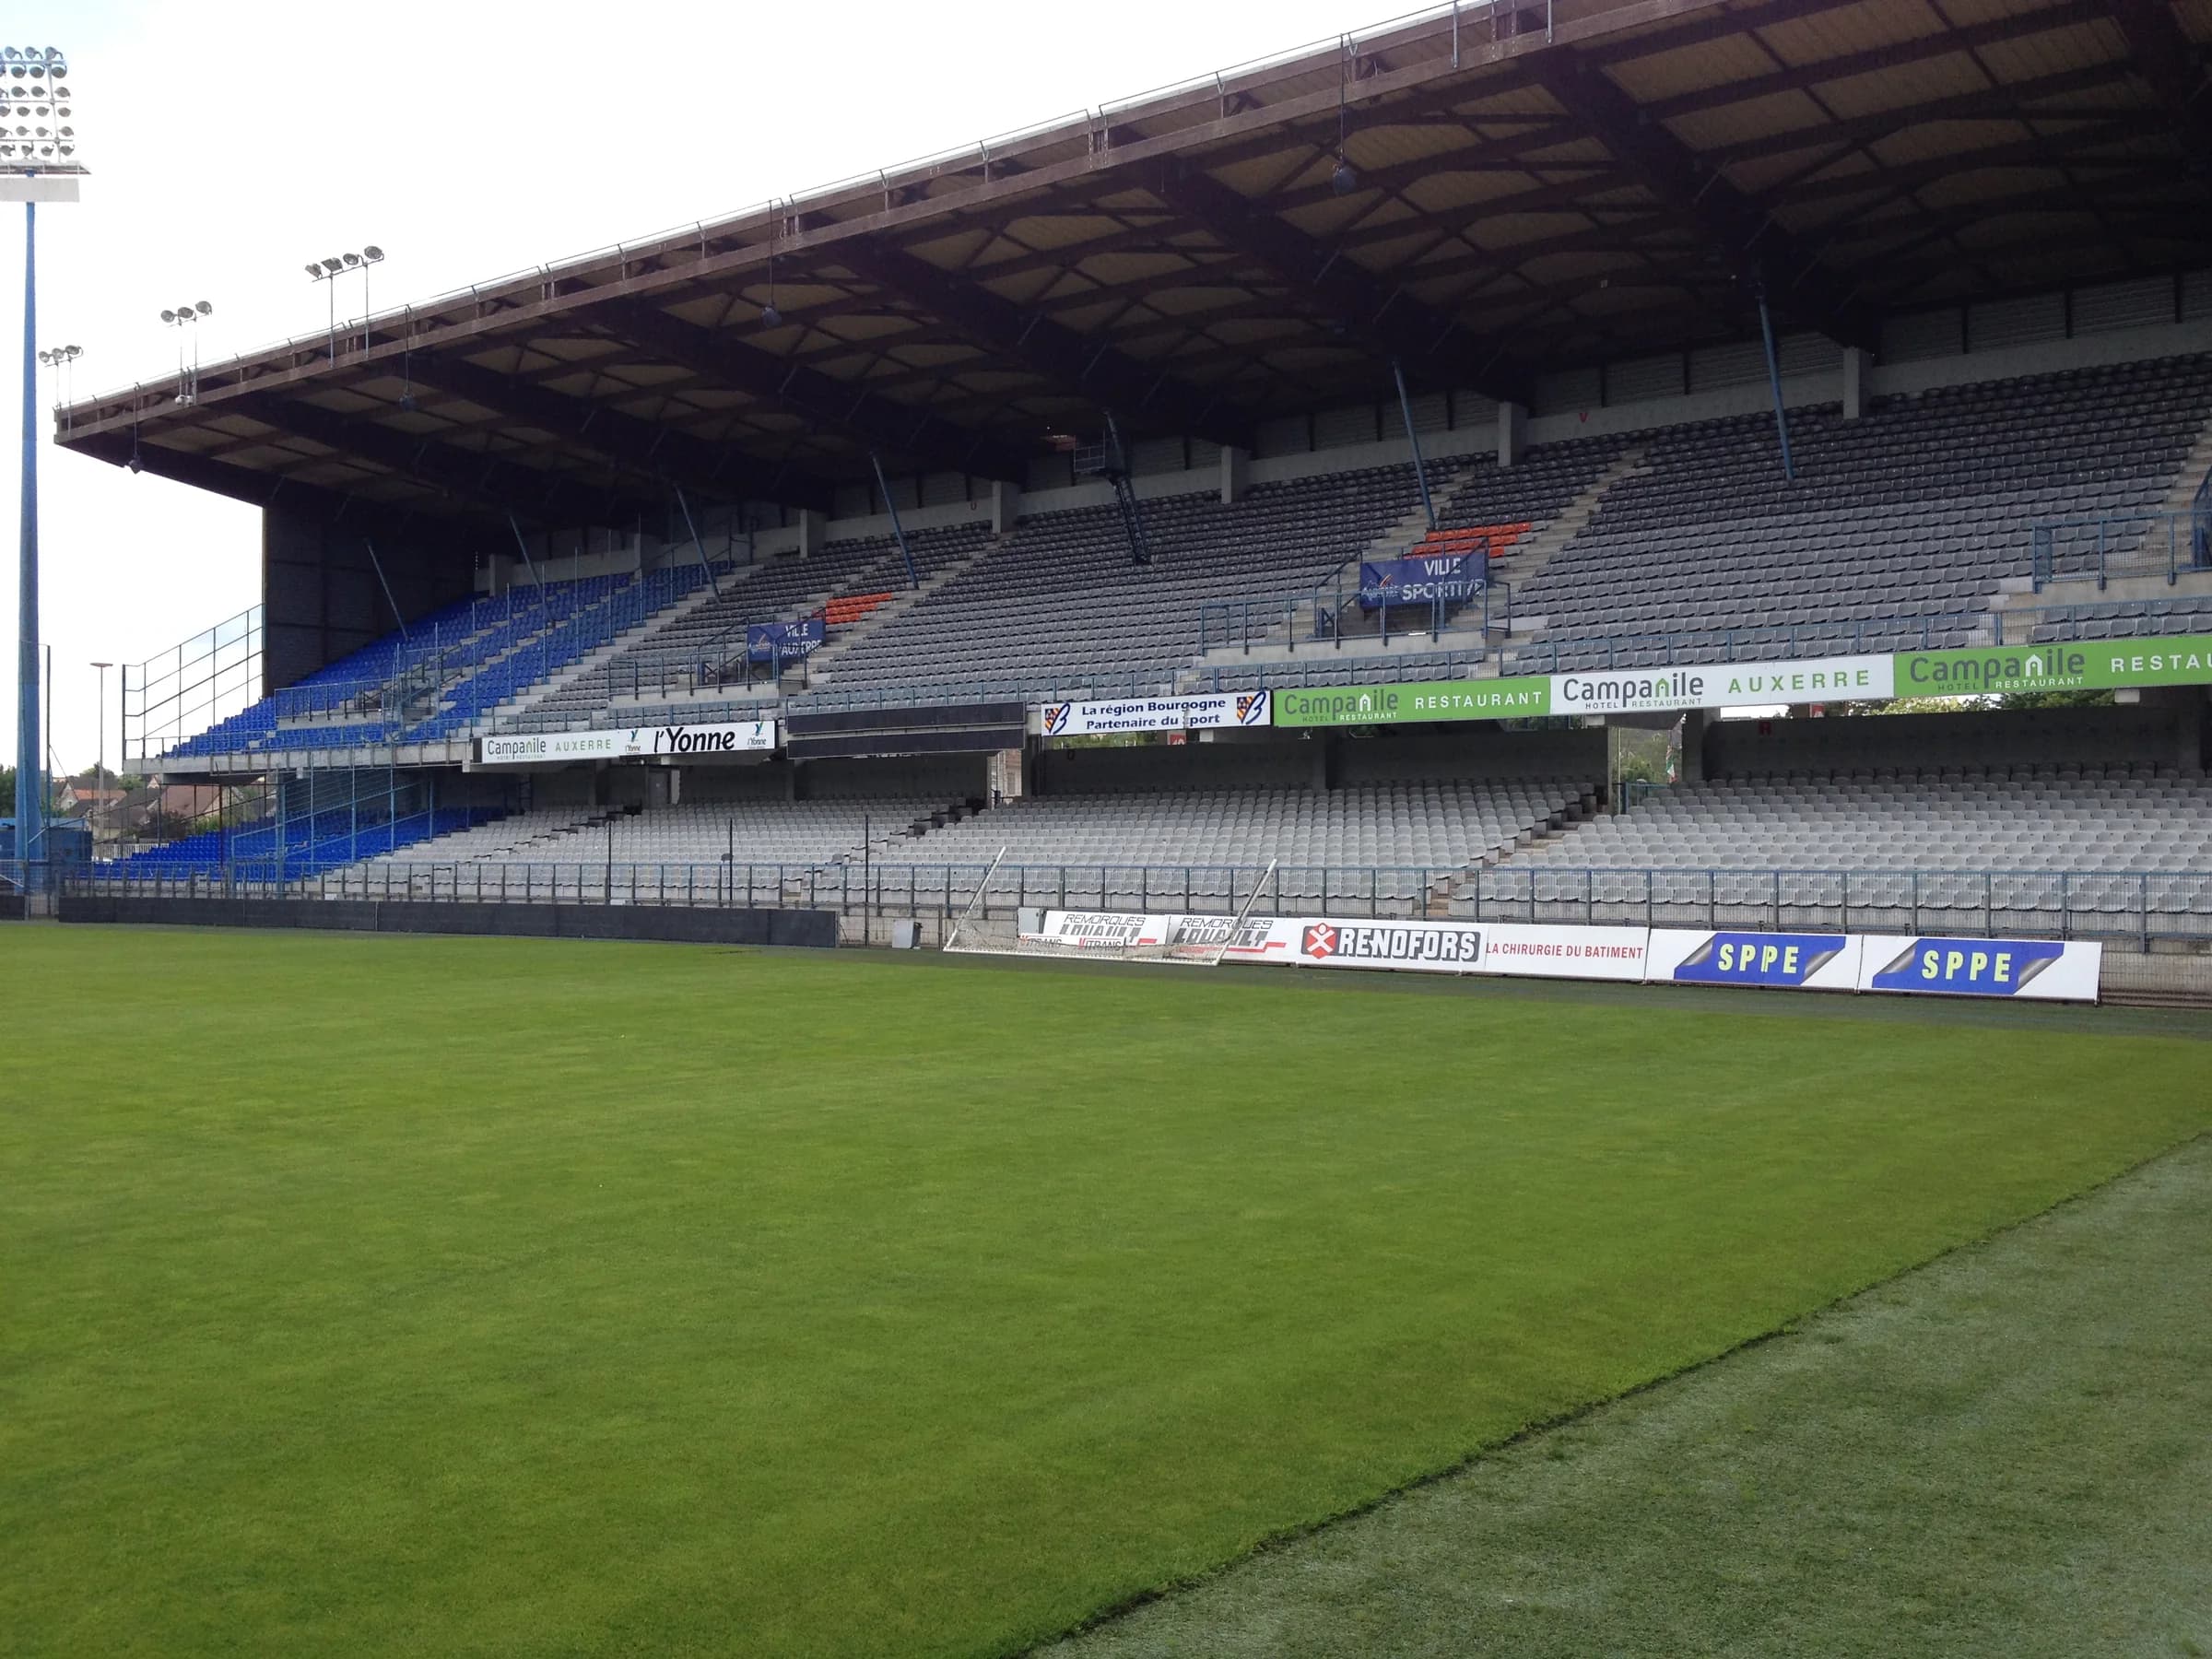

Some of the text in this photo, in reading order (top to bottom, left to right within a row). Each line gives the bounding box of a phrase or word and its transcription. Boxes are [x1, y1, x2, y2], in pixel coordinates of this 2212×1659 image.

[1424, 558, 1461, 576] VILLE
[785, 623, 809, 637] VILE
[1910, 648, 2086, 688] Campanile
[1563, 670, 1869, 708] Campanile AUXERRE
[1937, 677, 2083, 691] HOTEL RESTAURANT
[1082, 700, 1227, 716] La région Bourgogne
[1284, 688, 1543, 721] Campanile RESTAURANT
[1632, 698, 1701, 708] RESTAURANT
[1087, 714, 1221, 729] Partenaire du port
[1340, 712, 1397, 721] RESTAURANT
[488, 737, 612, 759] Campanile AUXERRE
[653, 726, 736, 754] l'Yonne
[1064, 914, 1147, 927] REMORQUES
[1338, 927, 1477, 962] RENOFORS
[1486, 942, 1643, 959] LA CHIRURGIE DU BATIMENT
[1718, 943, 1799, 974] SPPE
[1921, 949, 2012, 982] SPPE
